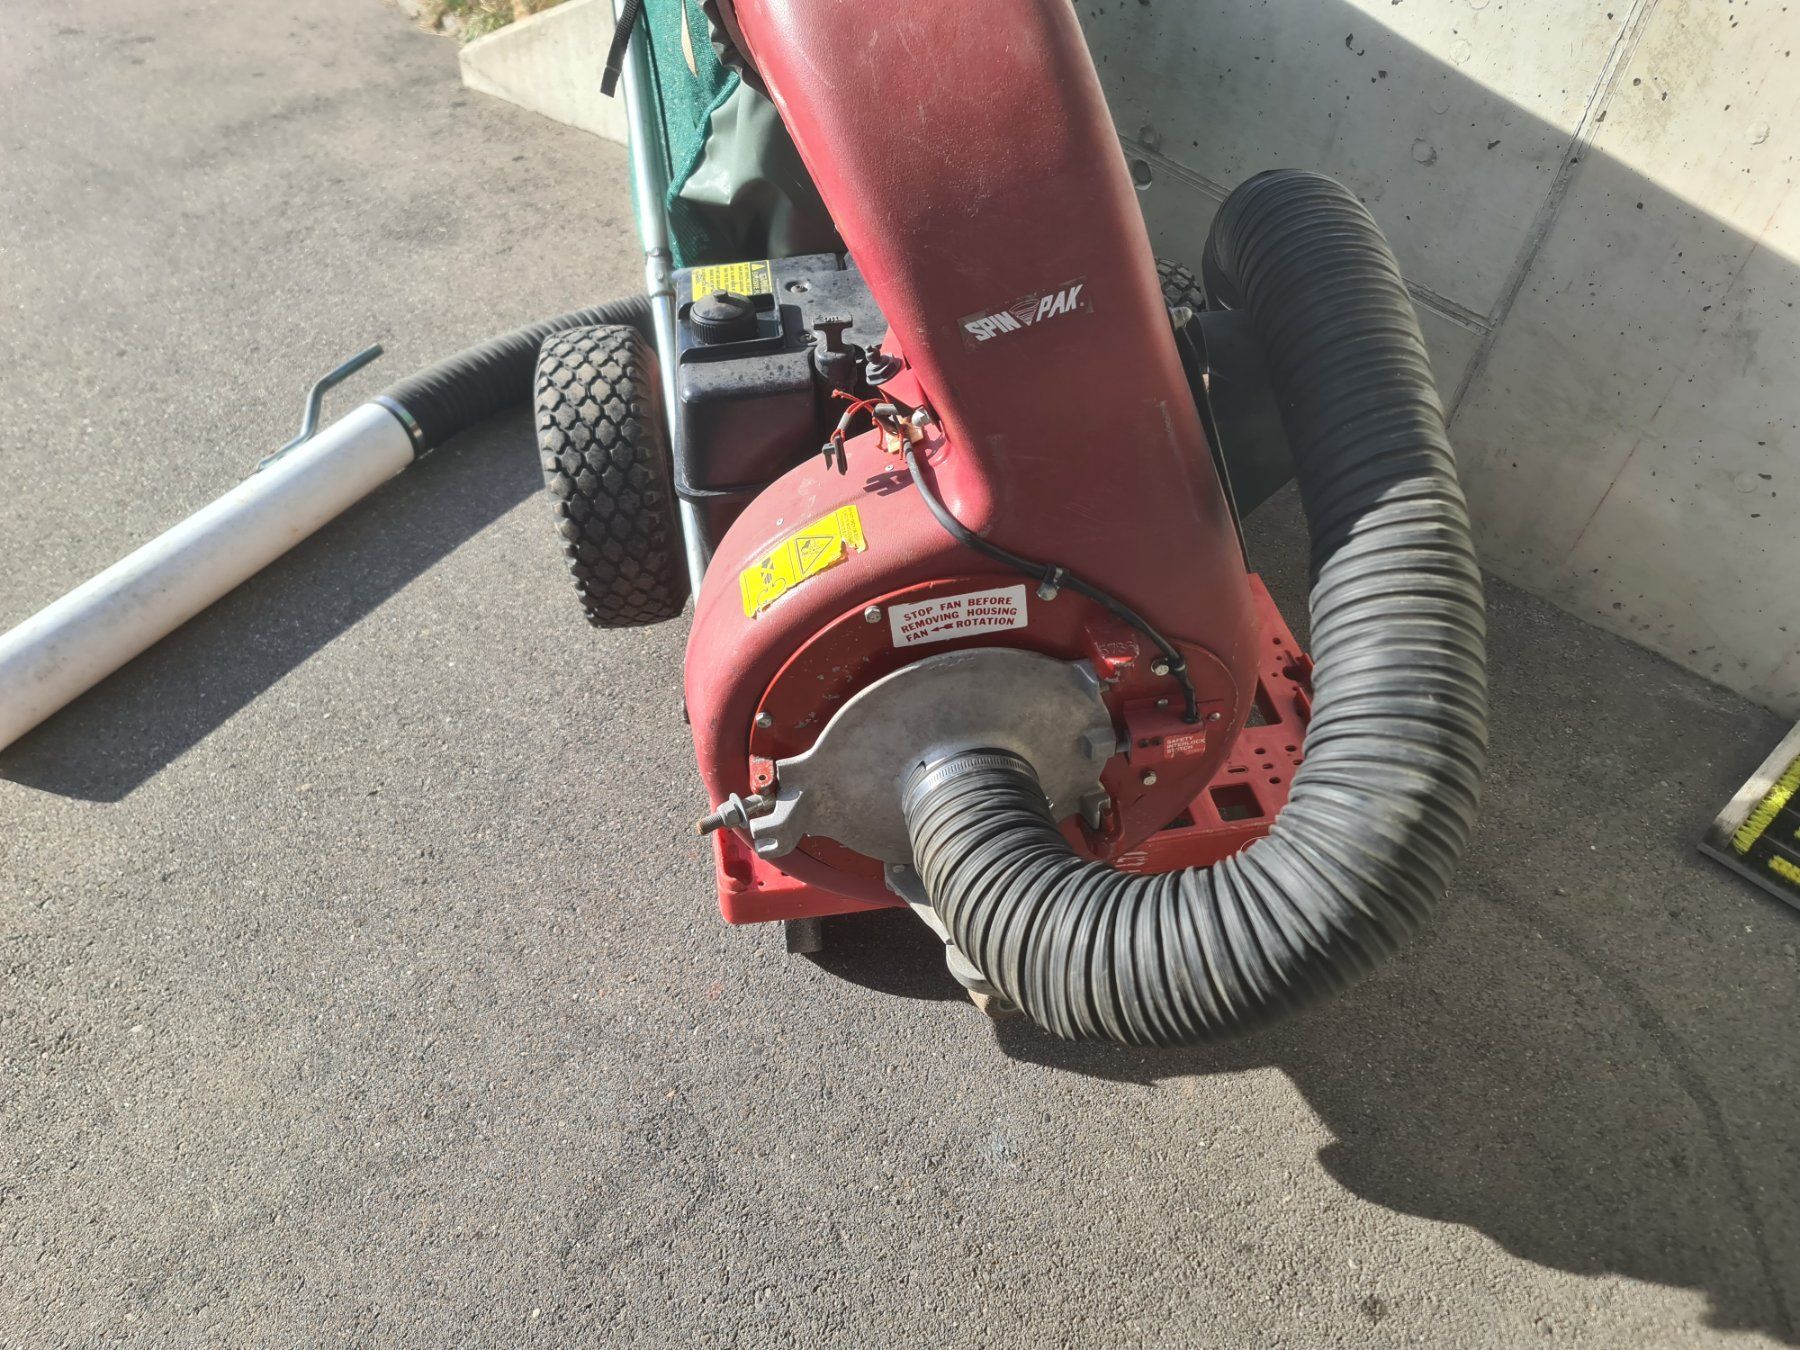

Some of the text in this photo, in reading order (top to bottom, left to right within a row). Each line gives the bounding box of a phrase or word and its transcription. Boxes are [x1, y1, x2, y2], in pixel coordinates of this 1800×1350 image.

[964, 284, 1083, 342] SPIN PAK
[901, 607, 1018, 634] REMOVING HOUSING
[903, 597, 1013, 622] STOP FAN BEFORE
[906, 617, 1015, 642] FAN ROTATION
[1167, 735, 1194, 744] SAFETY
